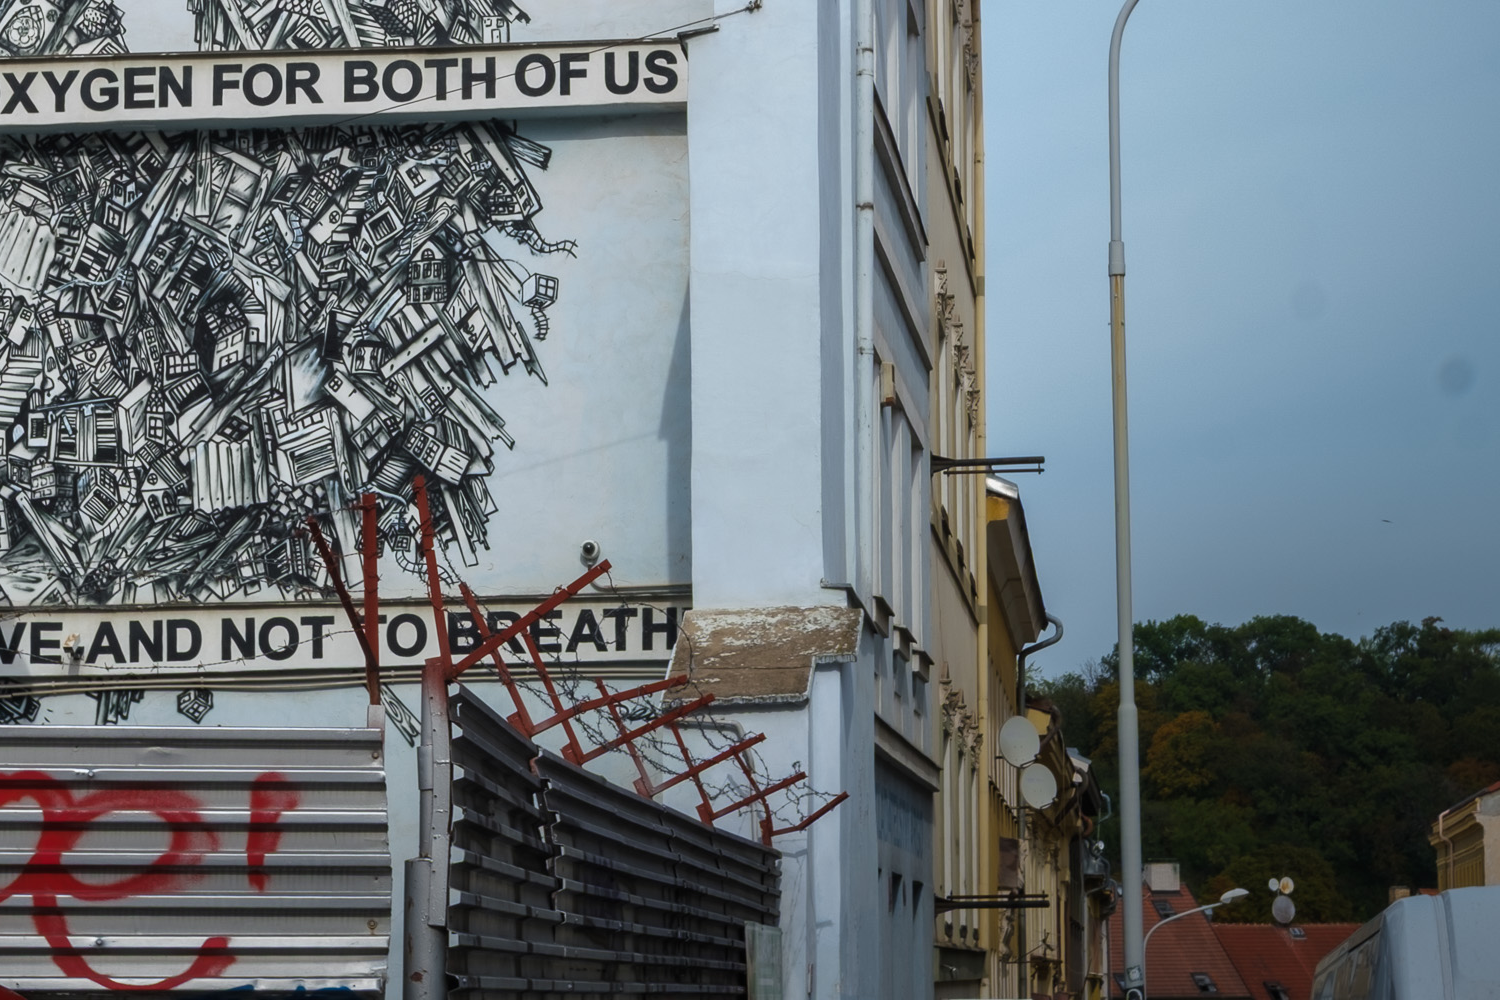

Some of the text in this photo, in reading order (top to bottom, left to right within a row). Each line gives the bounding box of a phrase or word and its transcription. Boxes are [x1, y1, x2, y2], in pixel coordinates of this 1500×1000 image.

[211, 61, 323, 107] FOR
[342, 56, 496, 103] BOTH
[514, 51, 590, 97] OF
[604, 49, 679, 95] US
[85, 619, 202, 664] AND
[221, 615, 335, 661] NOT
[447, 606, 692, 655] BREATH
